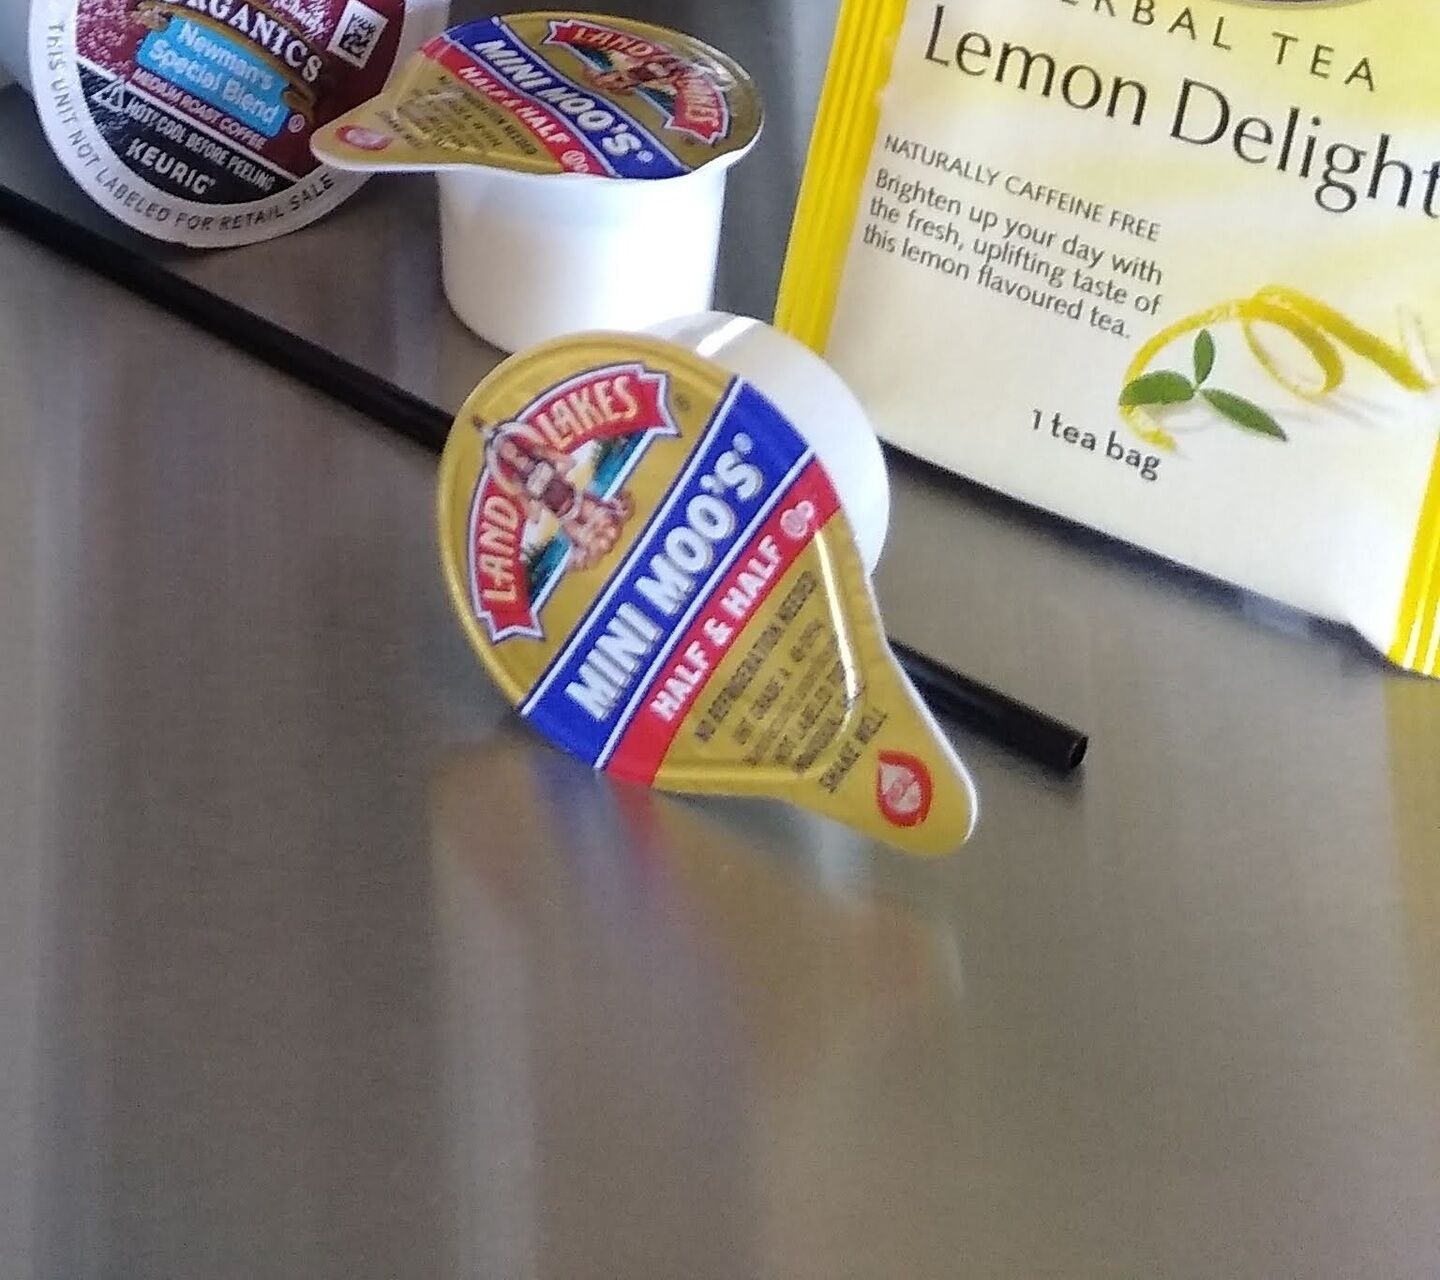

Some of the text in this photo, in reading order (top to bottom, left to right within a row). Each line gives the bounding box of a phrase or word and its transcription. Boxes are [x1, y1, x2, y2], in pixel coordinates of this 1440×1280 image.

[150, 39, 281, 125] Special Blend
[178, 22, 274, 90] Newman's
[574, 27, 655, 59] LAND
[1271, 31, 1378, 93] TEA
[47, 22, 336, 230] THIS UNIT NOT LABELED FOR RETAIL SALE
[157, 112, 187, 146] COOL
[186, 132, 229, 168] BEFORE
[227, 154, 276, 193] PEELING
[473, 39, 553, 88] MINI
[546, 85, 643, 158] MOO'S
[514, 105, 571, 145] HALF
[923, 5, 1440, 219] Lemon Delight
[124, 137, 211, 196] KEURIG
[884, 133, 1162, 243] NATURALLY CAFFEINE FREE
[861, 222, 1132, 340] this lemon flavoured tea.
[869, 196, 1164, 316] the fresh, uplifting taste of
[875, 167, 1164, 286] Brighten up your day with
[537, 375, 642, 455] LAKES
[1029, 406, 1163, 484] 1 tea bag
[482, 493, 522, 603] LAND
[564, 456, 763, 721] MINI MOO'S
[650, 539, 786, 722] HALF & HALF
